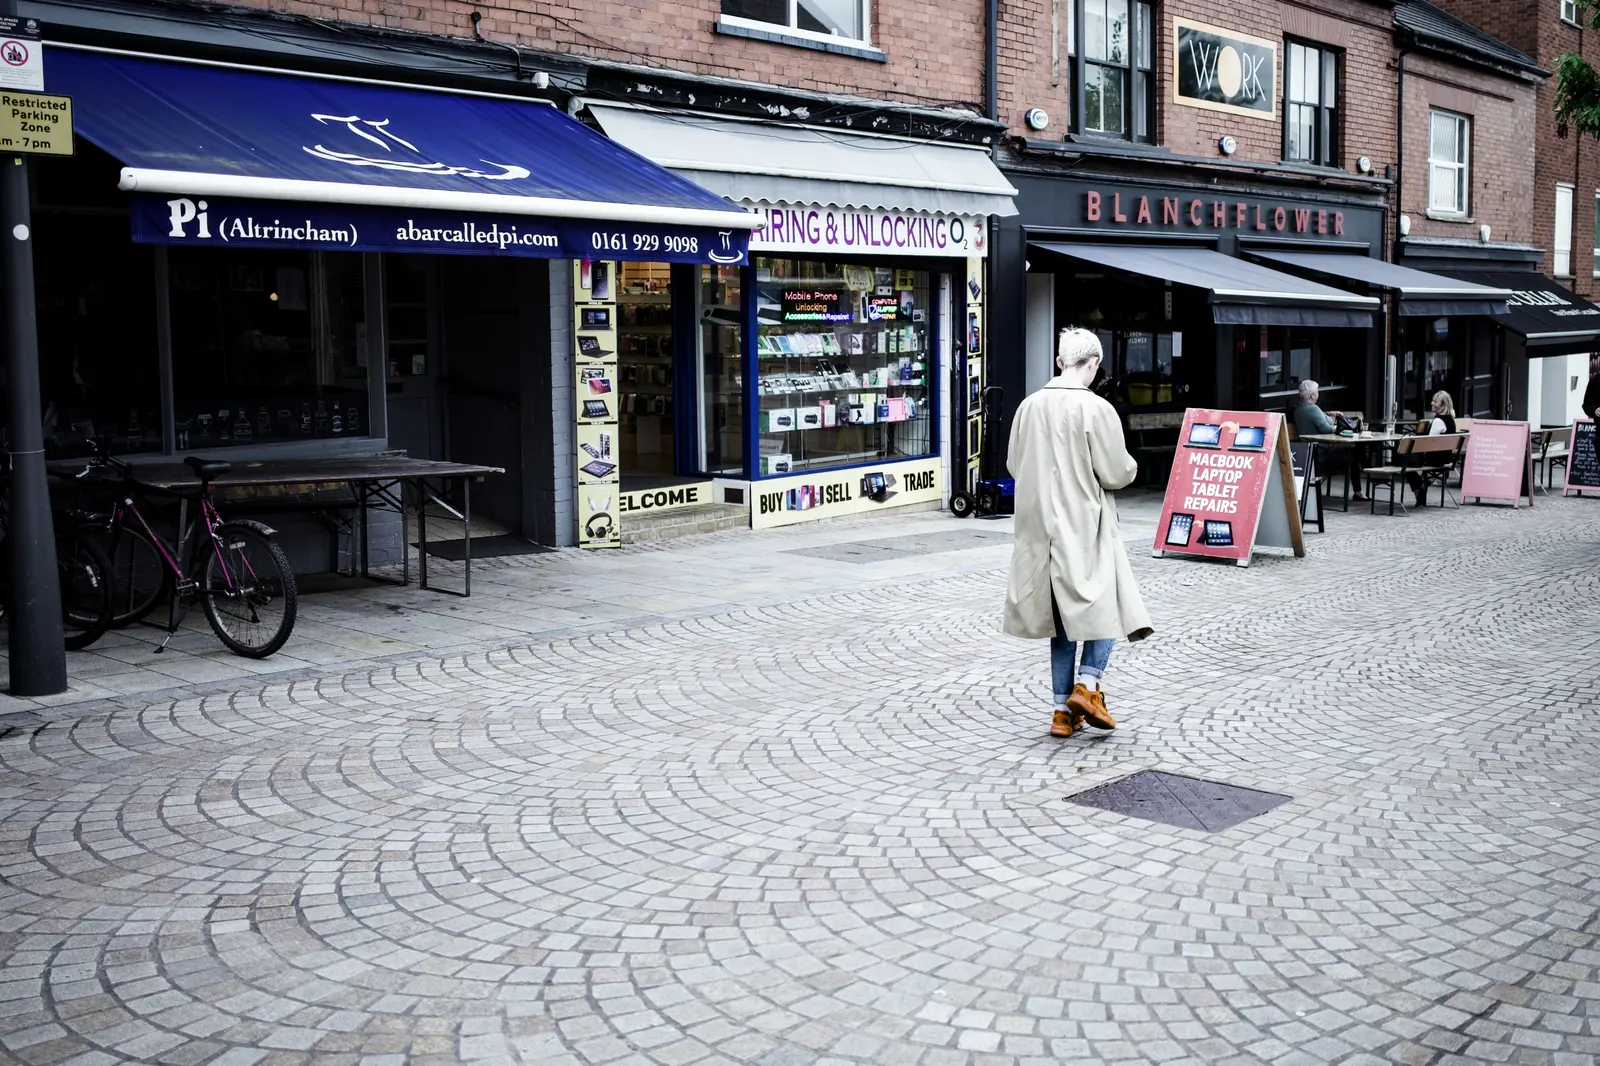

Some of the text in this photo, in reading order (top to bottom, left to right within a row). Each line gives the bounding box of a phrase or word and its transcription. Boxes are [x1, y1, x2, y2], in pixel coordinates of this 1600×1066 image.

[1189, 39, 1267, 102] WORK
[2, 96, 67, 111] Restricted
[12, 109, 59, 124] Parking
[21, 122, 51, 133] Zone
[166, 198, 358, 246] Pi (Altrincham)
[1086, 190, 1344, 236] BLANCHFLOWER
[396, 220, 559, 250] abarcalledpi.com
[825, 211, 839, 245] &
[843, 213, 947, 249] UNLOCKING
[592, 232, 698, 254] 0161 929 9098
[784, 291, 838, 300] Mobile Phone
[795, 302, 828, 312] Unlocking
[1188, 452, 1254, 470] MACBOOK
[1192, 468, 1243, 484] LAPTOP
[760, 470, 935, 514] BUY SELL TRADE
[1192, 482, 1238, 498] TABLET
[620, 487, 698, 512] ELCOME
[1184, 496, 1238, 514] REPAIRS
